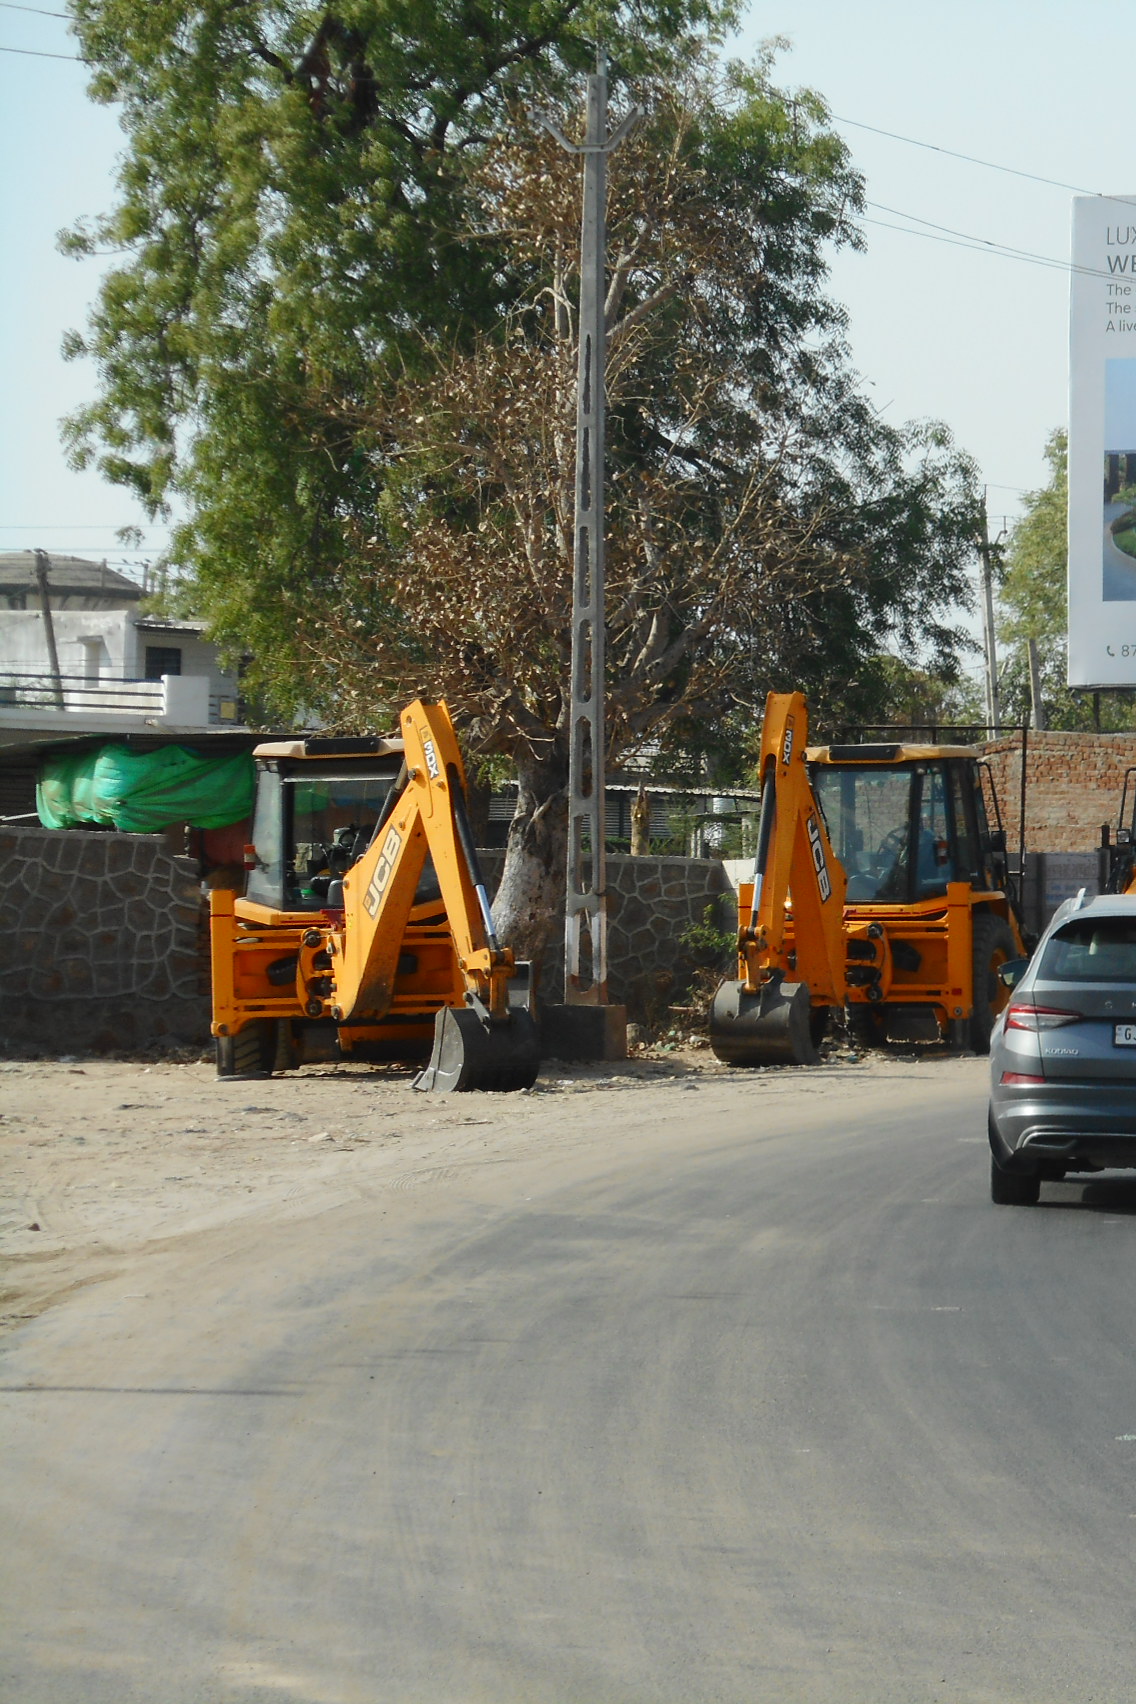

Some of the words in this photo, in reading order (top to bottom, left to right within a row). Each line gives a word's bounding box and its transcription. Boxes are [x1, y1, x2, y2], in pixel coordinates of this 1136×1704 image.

[1106, 283, 1132, 296] The
[1106, 301, 1132, 314] The
[1105, 320, 1116, 333] A
[423, 740, 440, 779] 3DX
[367, 827, 402, 917] JCB
[807, 819, 832, 902] JCB
